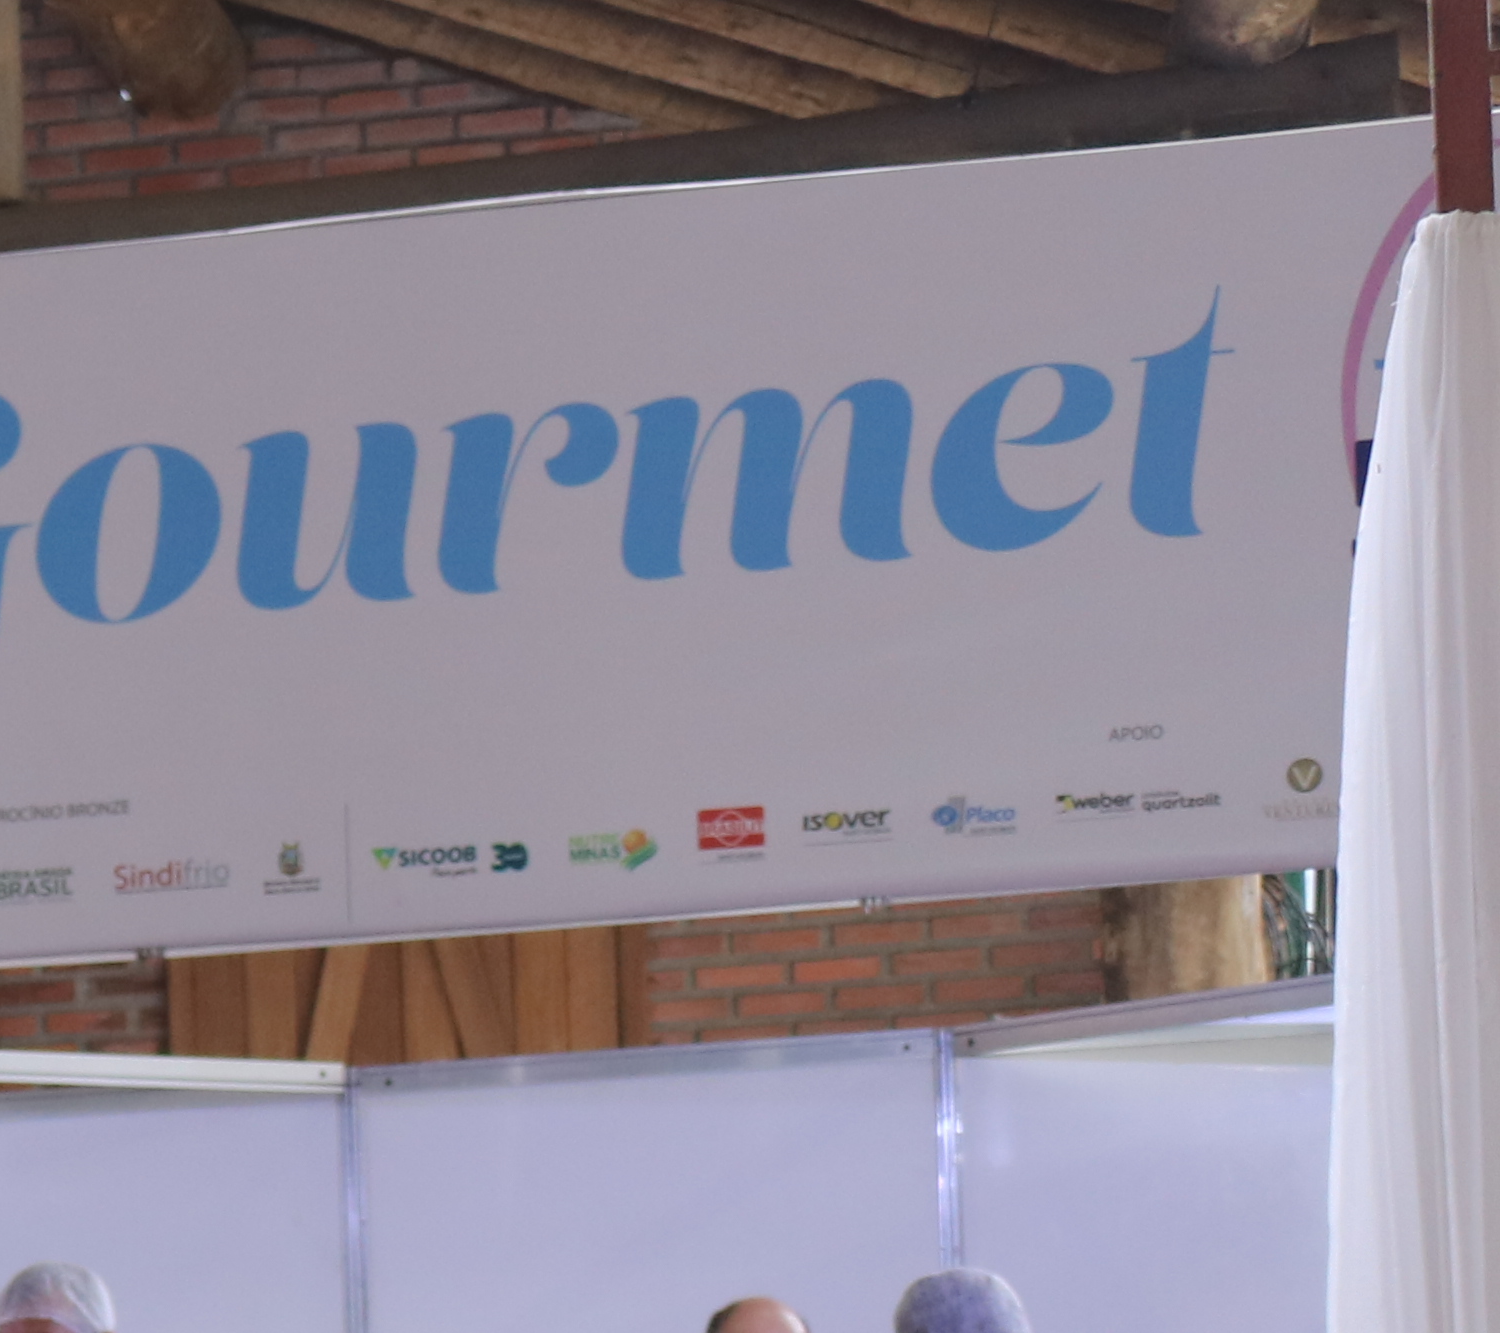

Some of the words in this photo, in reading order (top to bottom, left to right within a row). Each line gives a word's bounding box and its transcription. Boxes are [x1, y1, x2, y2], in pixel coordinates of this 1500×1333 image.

[1108, 725, 1164, 741] APOIO
[67, 800, 130, 818] BRONZE
[1073, 793, 1134, 810] weber
[398, 846, 477, 867] SICOOB
[114, 858, 230, 892] Sindifrio
